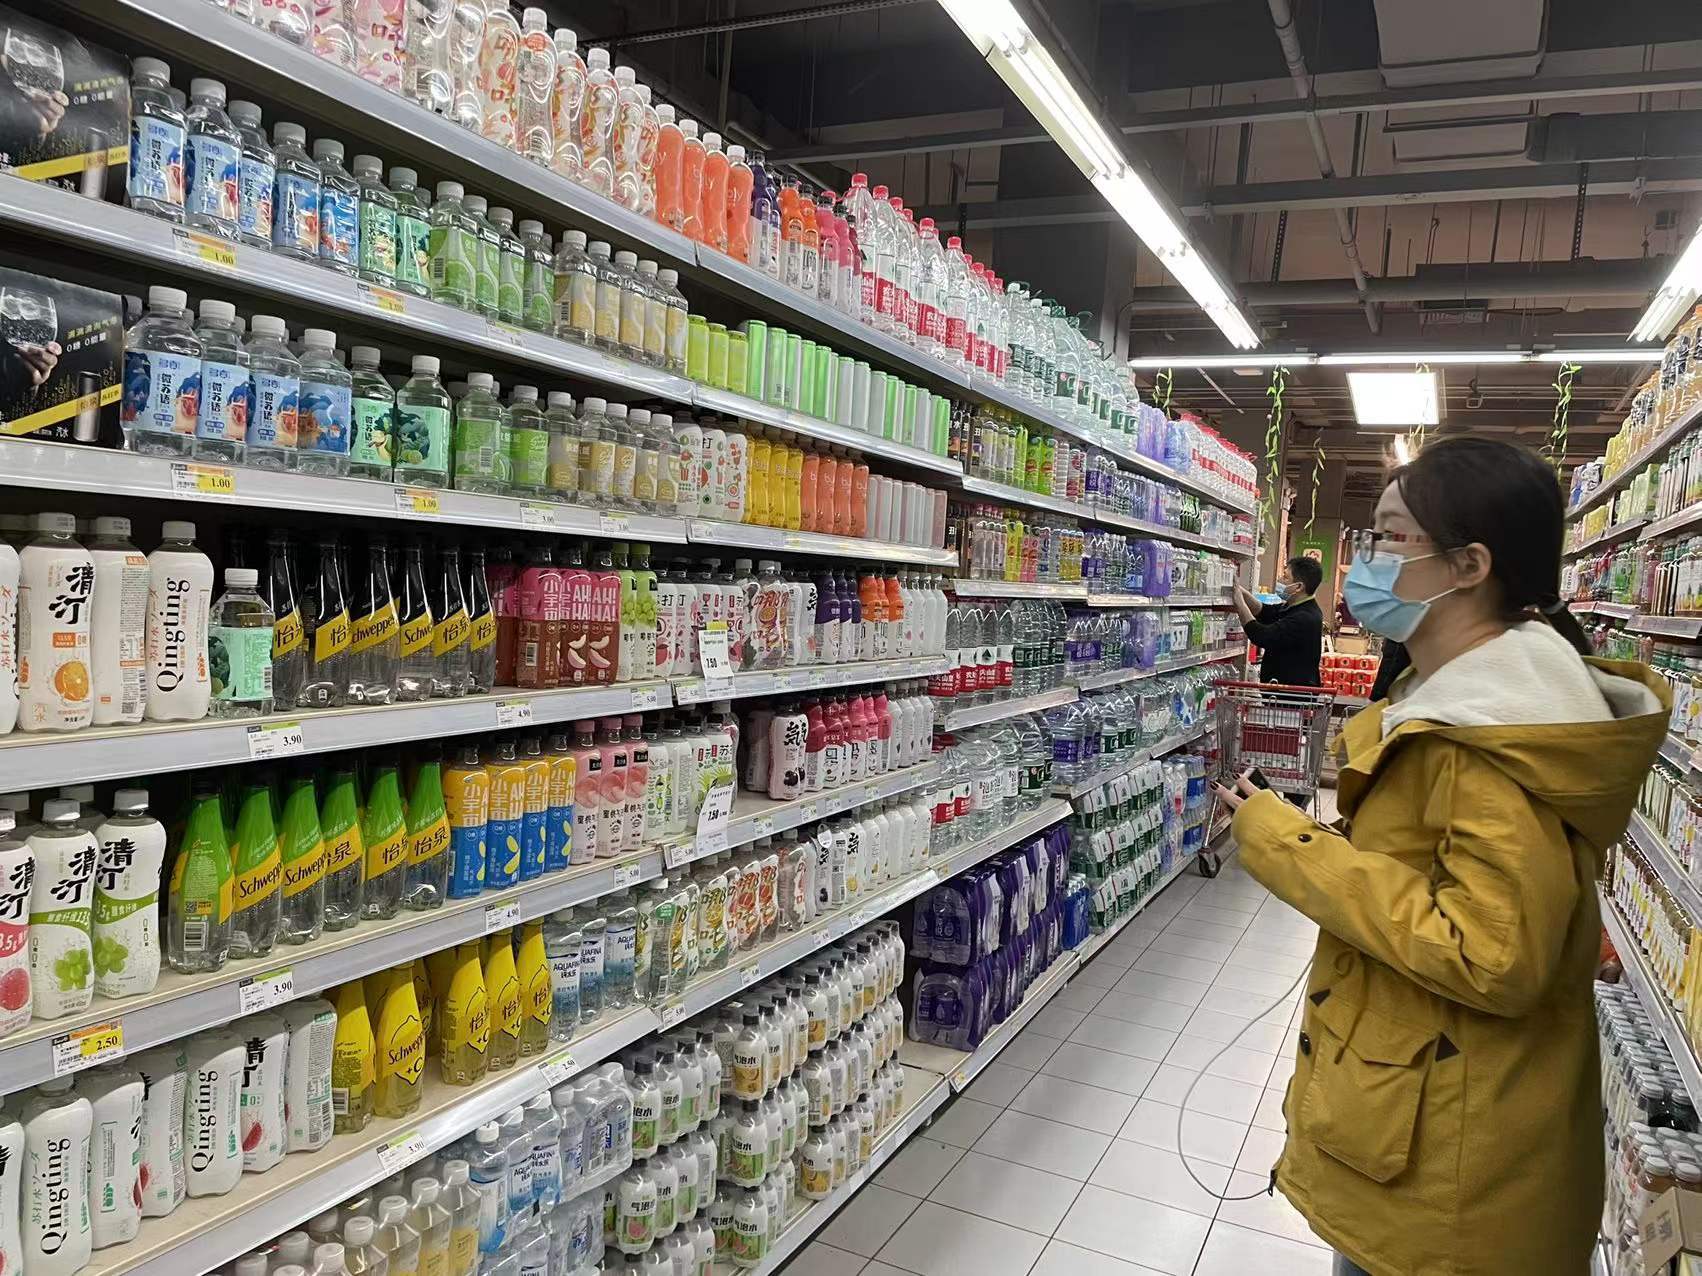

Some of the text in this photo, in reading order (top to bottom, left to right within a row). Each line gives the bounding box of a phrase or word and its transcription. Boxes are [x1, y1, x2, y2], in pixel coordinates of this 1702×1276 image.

[211, 478, 230, 488] 1.00
[49, 562, 95, 625] 清汀
[592, 588, 617, 604] AH!
[591, 605, 617, 621] HA!
[156, 577, 190, 692] Qingting
[331, 622, 353, 647] 怡
[477, 621, 496, 641] 怡
[283, 735, 302, 746] 3.90
[327, 840, 352, 867] 泉
[415, 826, 448, 857] 怡泉
[51, 846, 97, 904] 清汀
[97, 838, 137, 890] 清汀
[0, 857, 35, 919] 清汀
[274, 980, 293, 996] 3.90
[535, 983, 551, 1005] 怡
[471, 1009, 490, 1034] 怡
[503, 998, 521, 1020] 怡
[96, 1035, 118, 1051] 2.50
[406, 1057, 423, 1075] +C
[191, 1069, 219, 1173] Qingting
[41, 1138, 71, 1255] Qingting
